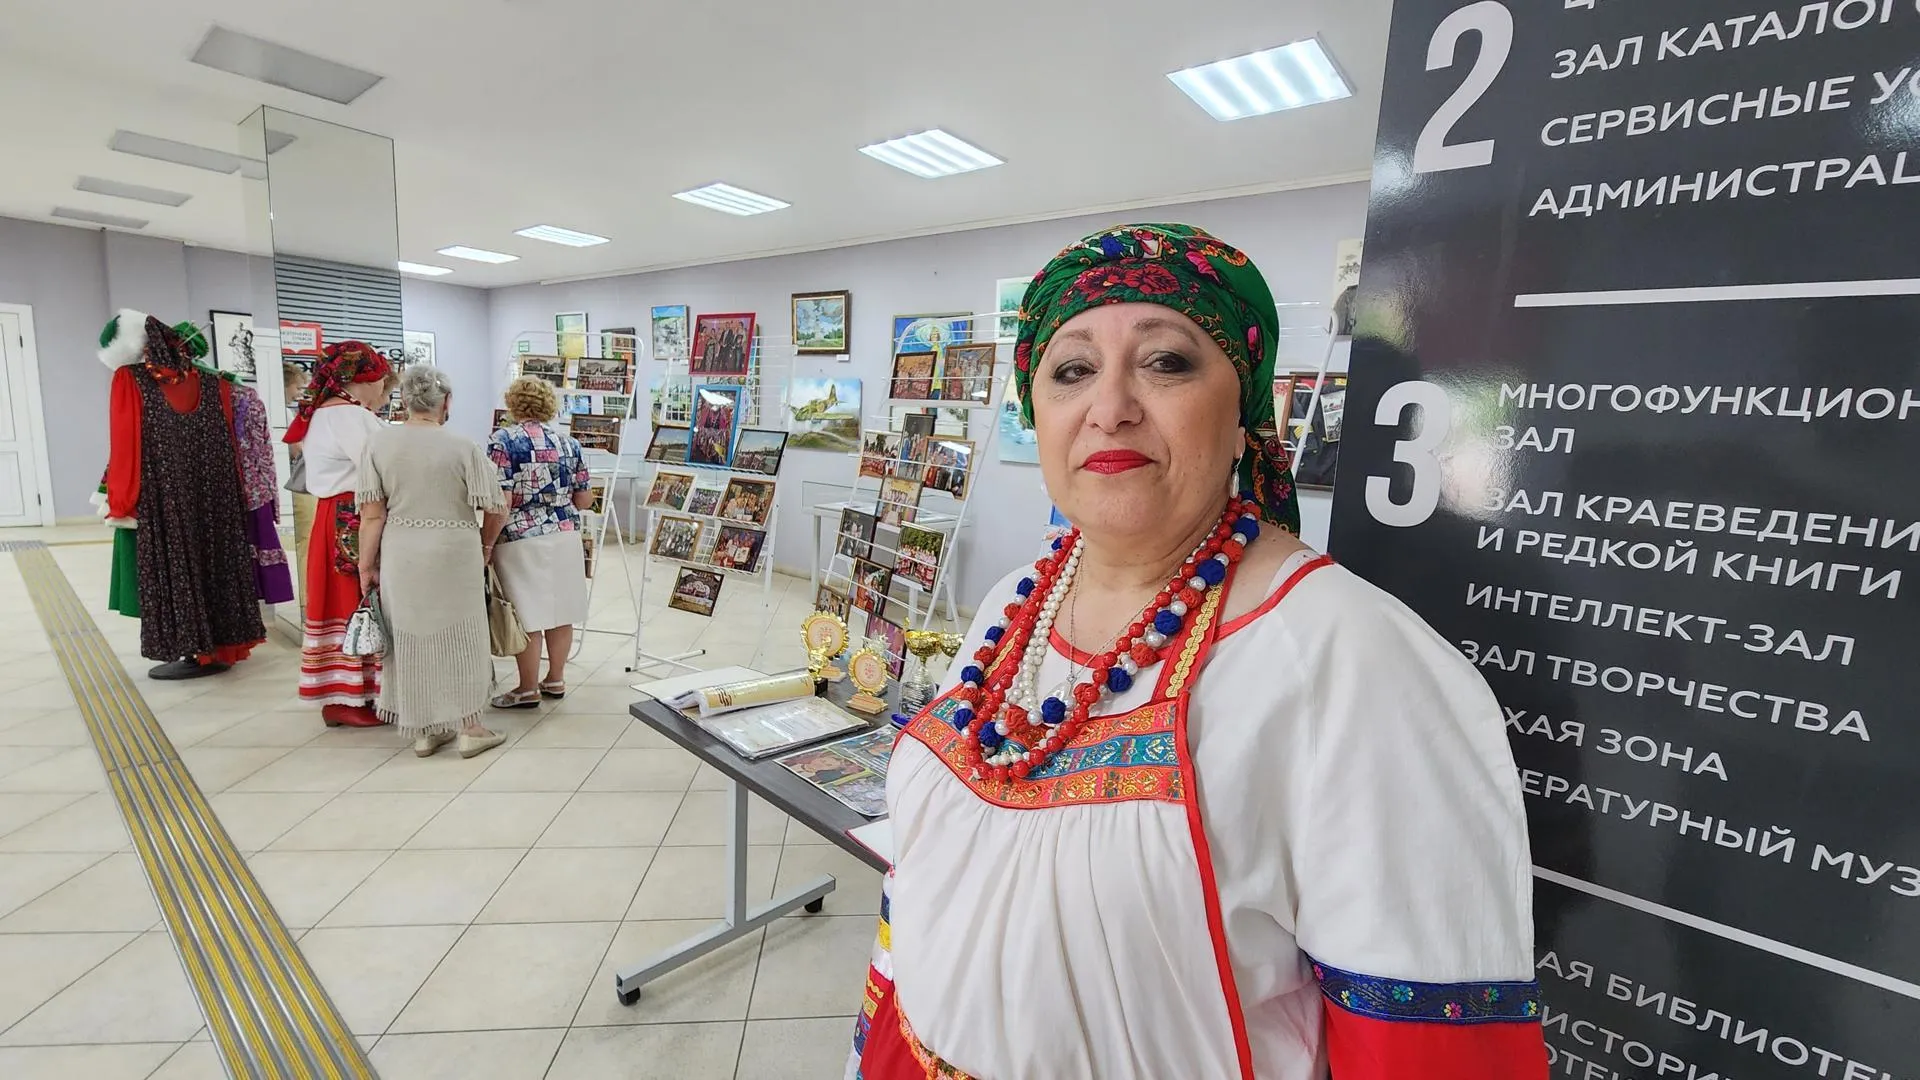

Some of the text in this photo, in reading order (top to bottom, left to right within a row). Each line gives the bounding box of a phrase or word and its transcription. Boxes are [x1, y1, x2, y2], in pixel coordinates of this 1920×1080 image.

[1413, 0, 1514, 174] 2
[1551, 36, 1644, 79] ЗАЛ
[1541, 76, 1855, 146] СЕРВИСНЫЕ
[1499, 383, 1920, 422] МНОГОФУНКЦИОН
[1365, 380, 1451, 528] 3
[1493, 425, 1575, 454] ЗАЛ
[1483, 487, 1920, 552] ЗАЛ КРАЕВЕДЕНИ
[1477, 526, 1902, 599] И РЕДКОЙ КНИГИ
[1466, 583, 1855, 666] ИНТЕЛЛЕКТ-ЗАЛ
[1460, 640, 1870, 742] ЗАЛ ТВОРЧЕСТВА
[1596, 728, 1728, 781] ЗОНА
[1516, 766, 1796, 863] ЕРАТУРНЫЙ
[1606, 973, 1891, 1080] БИБЛИОТЕ
